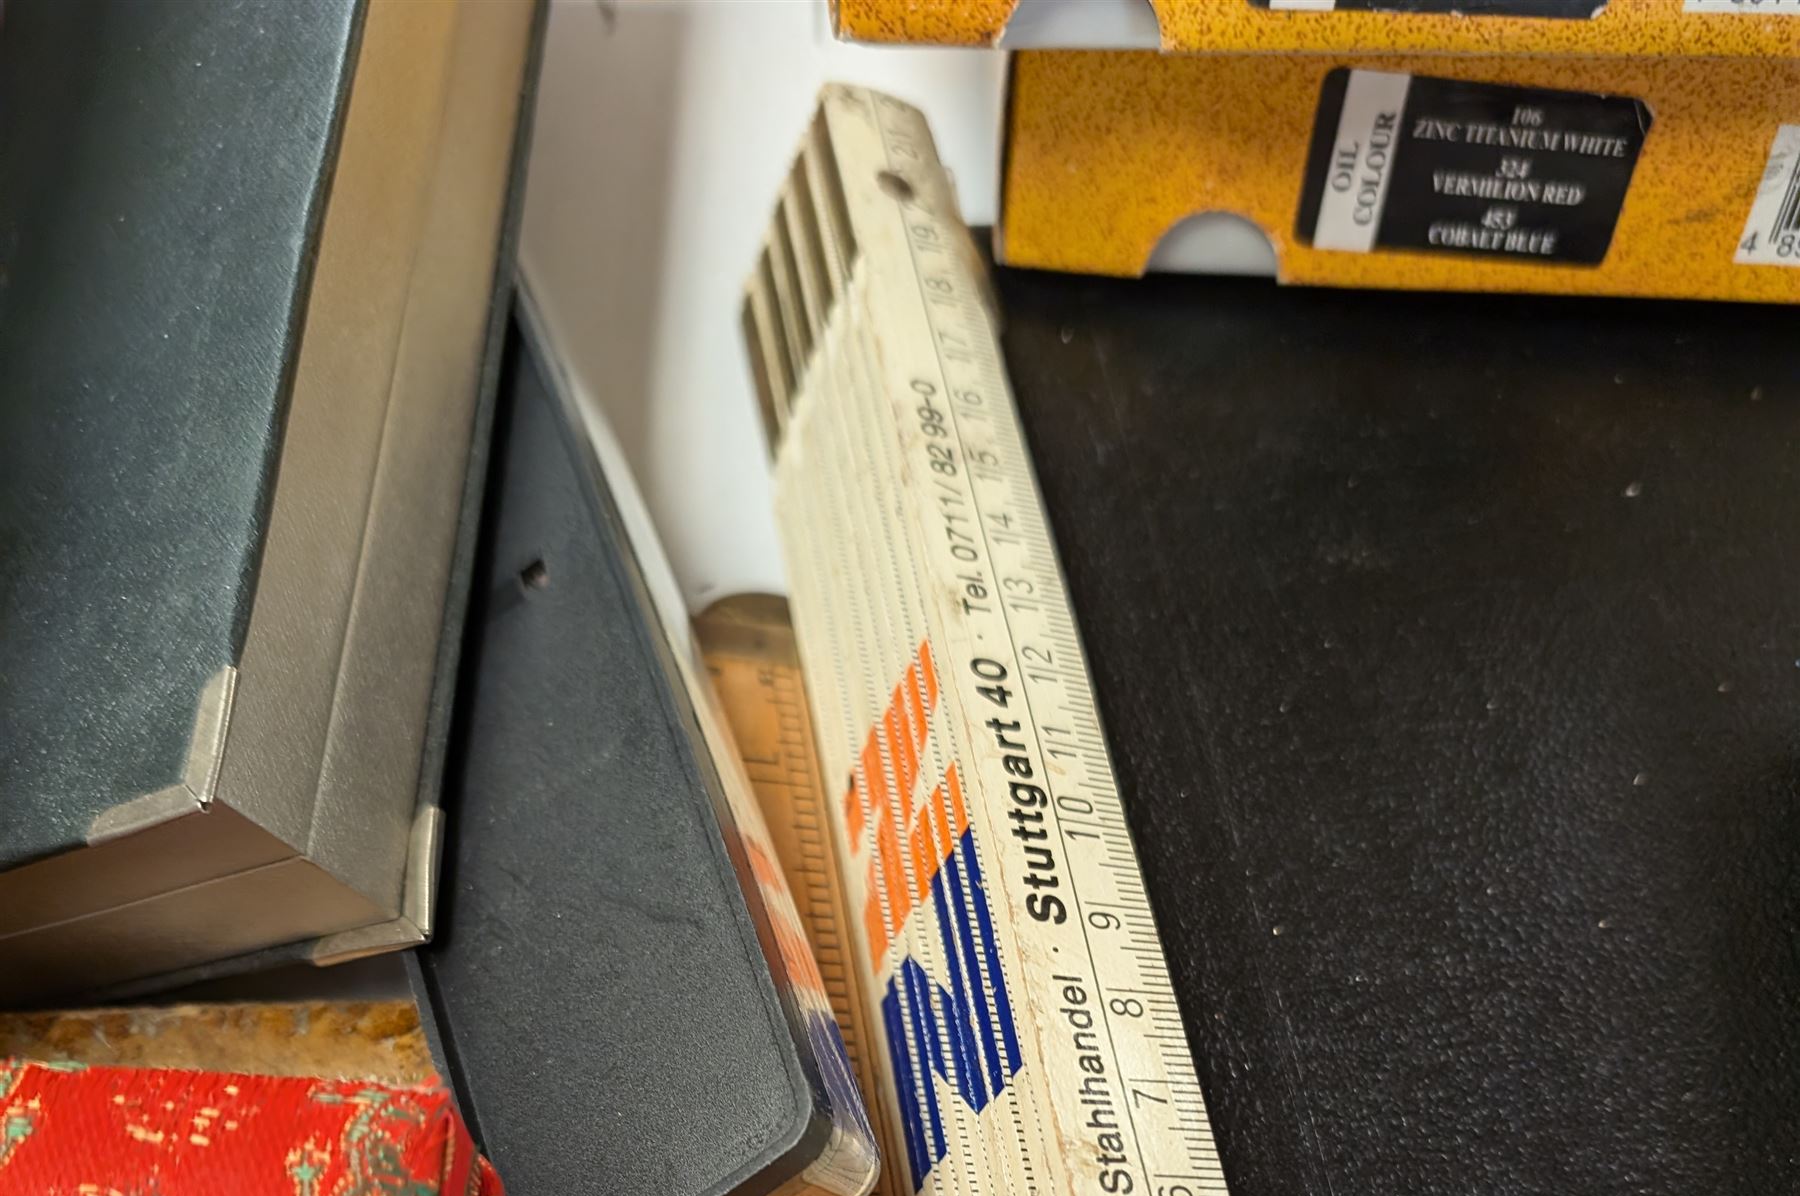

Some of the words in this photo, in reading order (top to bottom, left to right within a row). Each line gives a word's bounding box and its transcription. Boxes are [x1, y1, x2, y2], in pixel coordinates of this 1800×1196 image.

[1413, 119, 1460, 142] ZINC
[1466, 124, 1560, 150] TITANIUM
[1564, 132, 1627, 157] WHITE
[1332, 142, 1359, 193] OIL
[1353, 111, 1397, 226] COLOUR
[1433, 171, 1541, 201] VERMILION
[1542, 184, 1585, 205] RED
[912, 225, 940, 255] 19
[1428, 223, 1503, 249] COBALT
[1504, 230, 1556, 254] BLUE
[1740, 231, 1758, 255] 4
[925, 278, 955, 309] 18
[938, 331, 972, 365] 17
[910, 380, 948, 438] 99-0
[954, 390, 987, 423] 16
[968, 450, 1002, 482] 15
[986, 512, 1021, 546] 14
[956, 571, 992, 616] Tel.
[1003, 577, 1039, 613] 13
[970, 657, 1013, 708] 40
[1022, 645, 1058, 685] 12
[1041, 724, 1078, 762] 11
[985, 718, 1066, 925] Stuttgart
[1057, 796, 1101, 841] 10
[1088, 911, 1121, 930] 9
[1109, 997, 1144, 1019] 8
[1052, 975, 1133, 1195] Stahlhandel
[1133, 1088, 1168, 1108] 7
